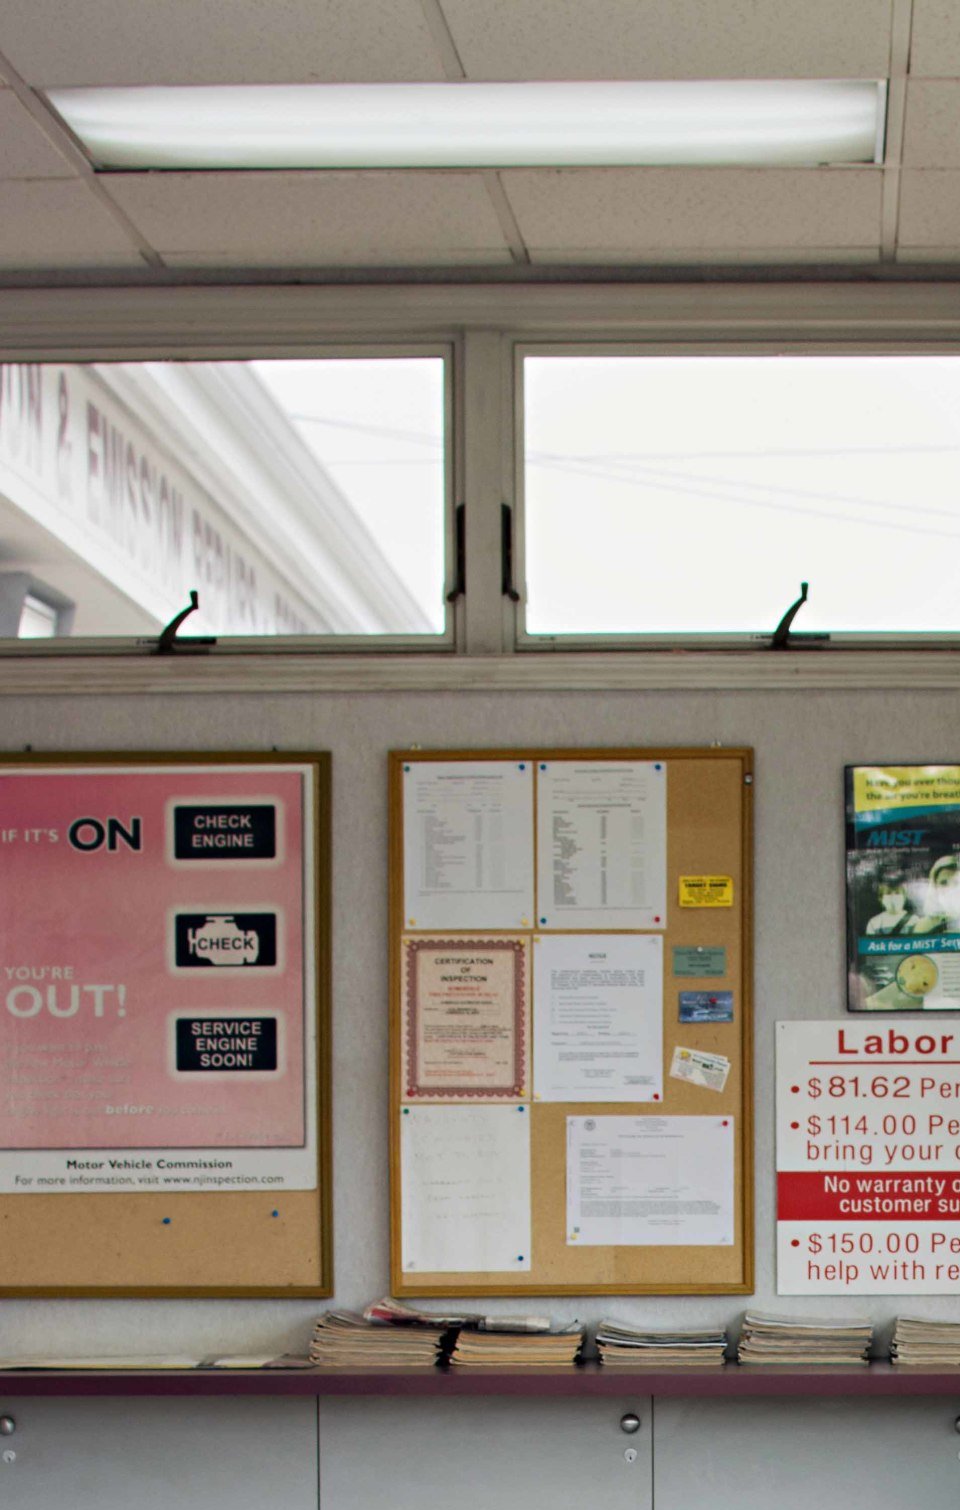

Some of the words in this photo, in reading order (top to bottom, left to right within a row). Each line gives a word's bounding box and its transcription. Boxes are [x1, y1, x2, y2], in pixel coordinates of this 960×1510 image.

[195, 815, 251, 828] CHECK
[2, 830, 16, 842] IF
[25, 829, 58, 842] IT'S
[66, 815, 143, 854] ON
[193, 834, 253, 847] ENGINE
[197, 935, 256, 953] CHECK
[868, 942, 886, 951] Ask
[888, 942, 902, 950] for
[5, 967, 73, 980] YOU'RE
[6, 984, 126, 1018] OUT!
[192, 1022, 261, 1035] SERVICE
[196, 1038, 256, 1051] ENGINE
[838, 1029, 953, 1055] Labor
[201, 1054, 252, 1067] SOON!
[920, 1077, 960, 1098] Per
[806, 1115, 917, 1138] $114.00
[806, 1141, 873, 1165] bring
[885, 1144, 943, 1164] your
[67, 1160, 104, 1169] Motor
[109, 1160, 152, 1169] Vehicle
[157, 1159, 232, 1169] Commission
[15, 1176, 32, 1185] For
[164, 1177, 284, 1185] www.njinspection.com
[825, 1176, 850, 1193] No
[857, 1177, 945, 1196] warranty
[840, 1197, 931, 1212] customer
[807, 1232, 920, 1256] $150.00
[807, 1261, 860, 1284] help
[870, 1260, 926, 1280] with
